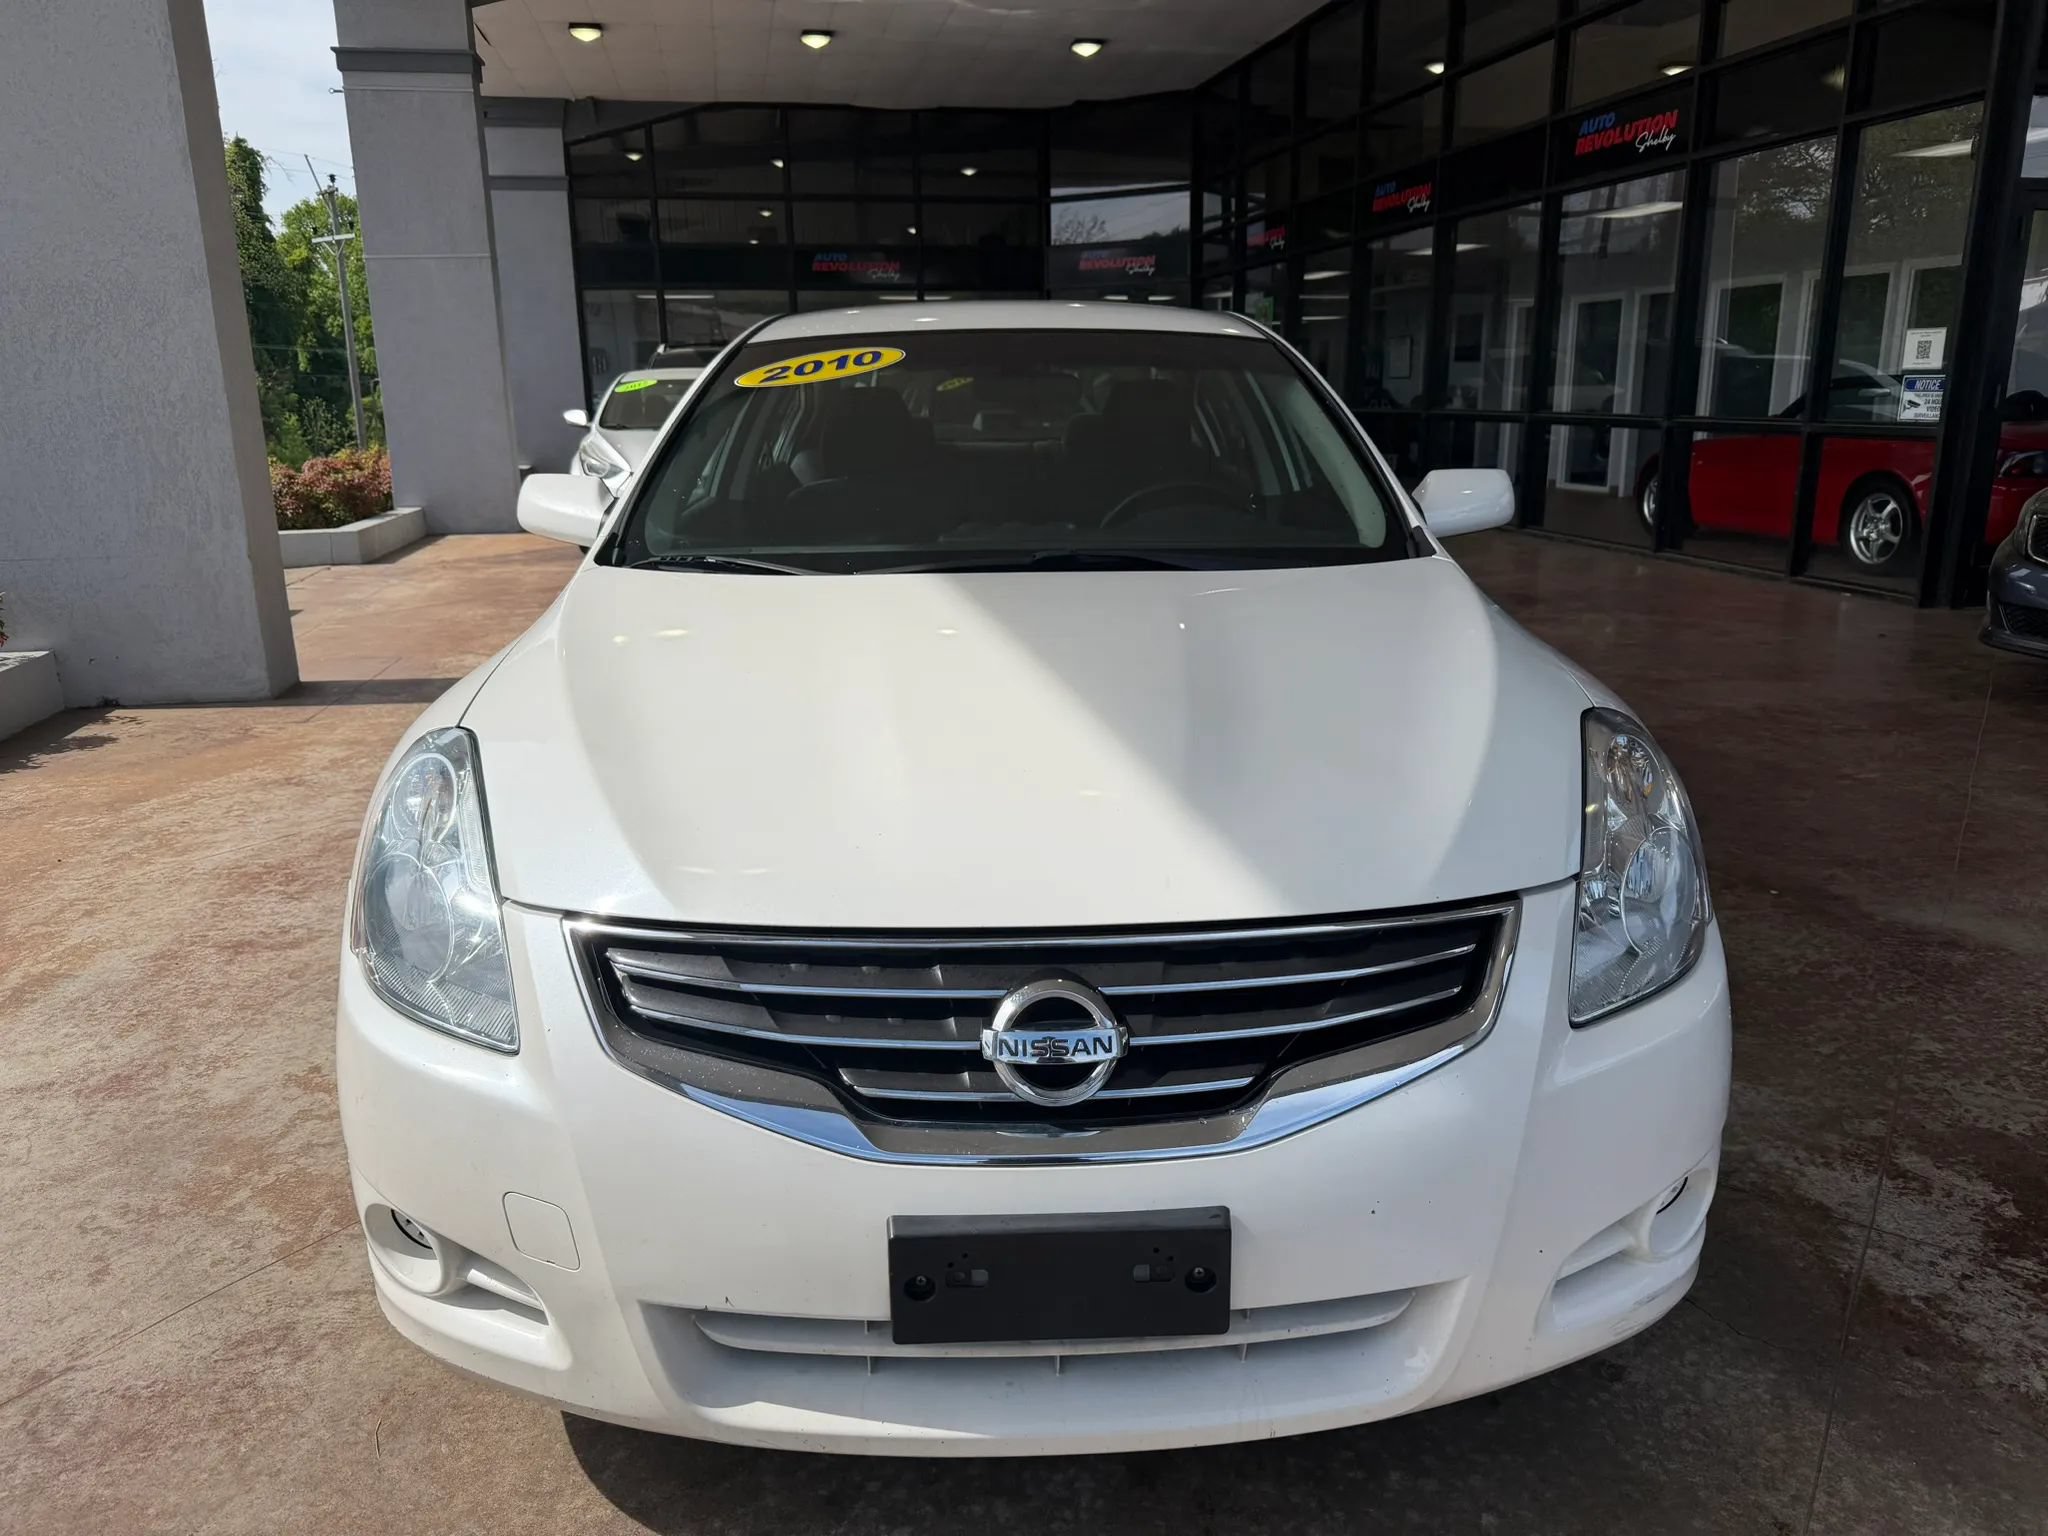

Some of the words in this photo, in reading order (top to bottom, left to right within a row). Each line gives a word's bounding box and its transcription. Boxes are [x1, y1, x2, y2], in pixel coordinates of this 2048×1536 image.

[1575, 108, 1679, 156] REVOLUTION
[1578, 112, 1616, 136] AUTO
[1635, 124, 1676, 153] Shelby
[758, 350, 883, 385] 2010
[1914, 379, 1942, 391] NOTICE
[999, 1034, 1113, 1058] NISSAN
